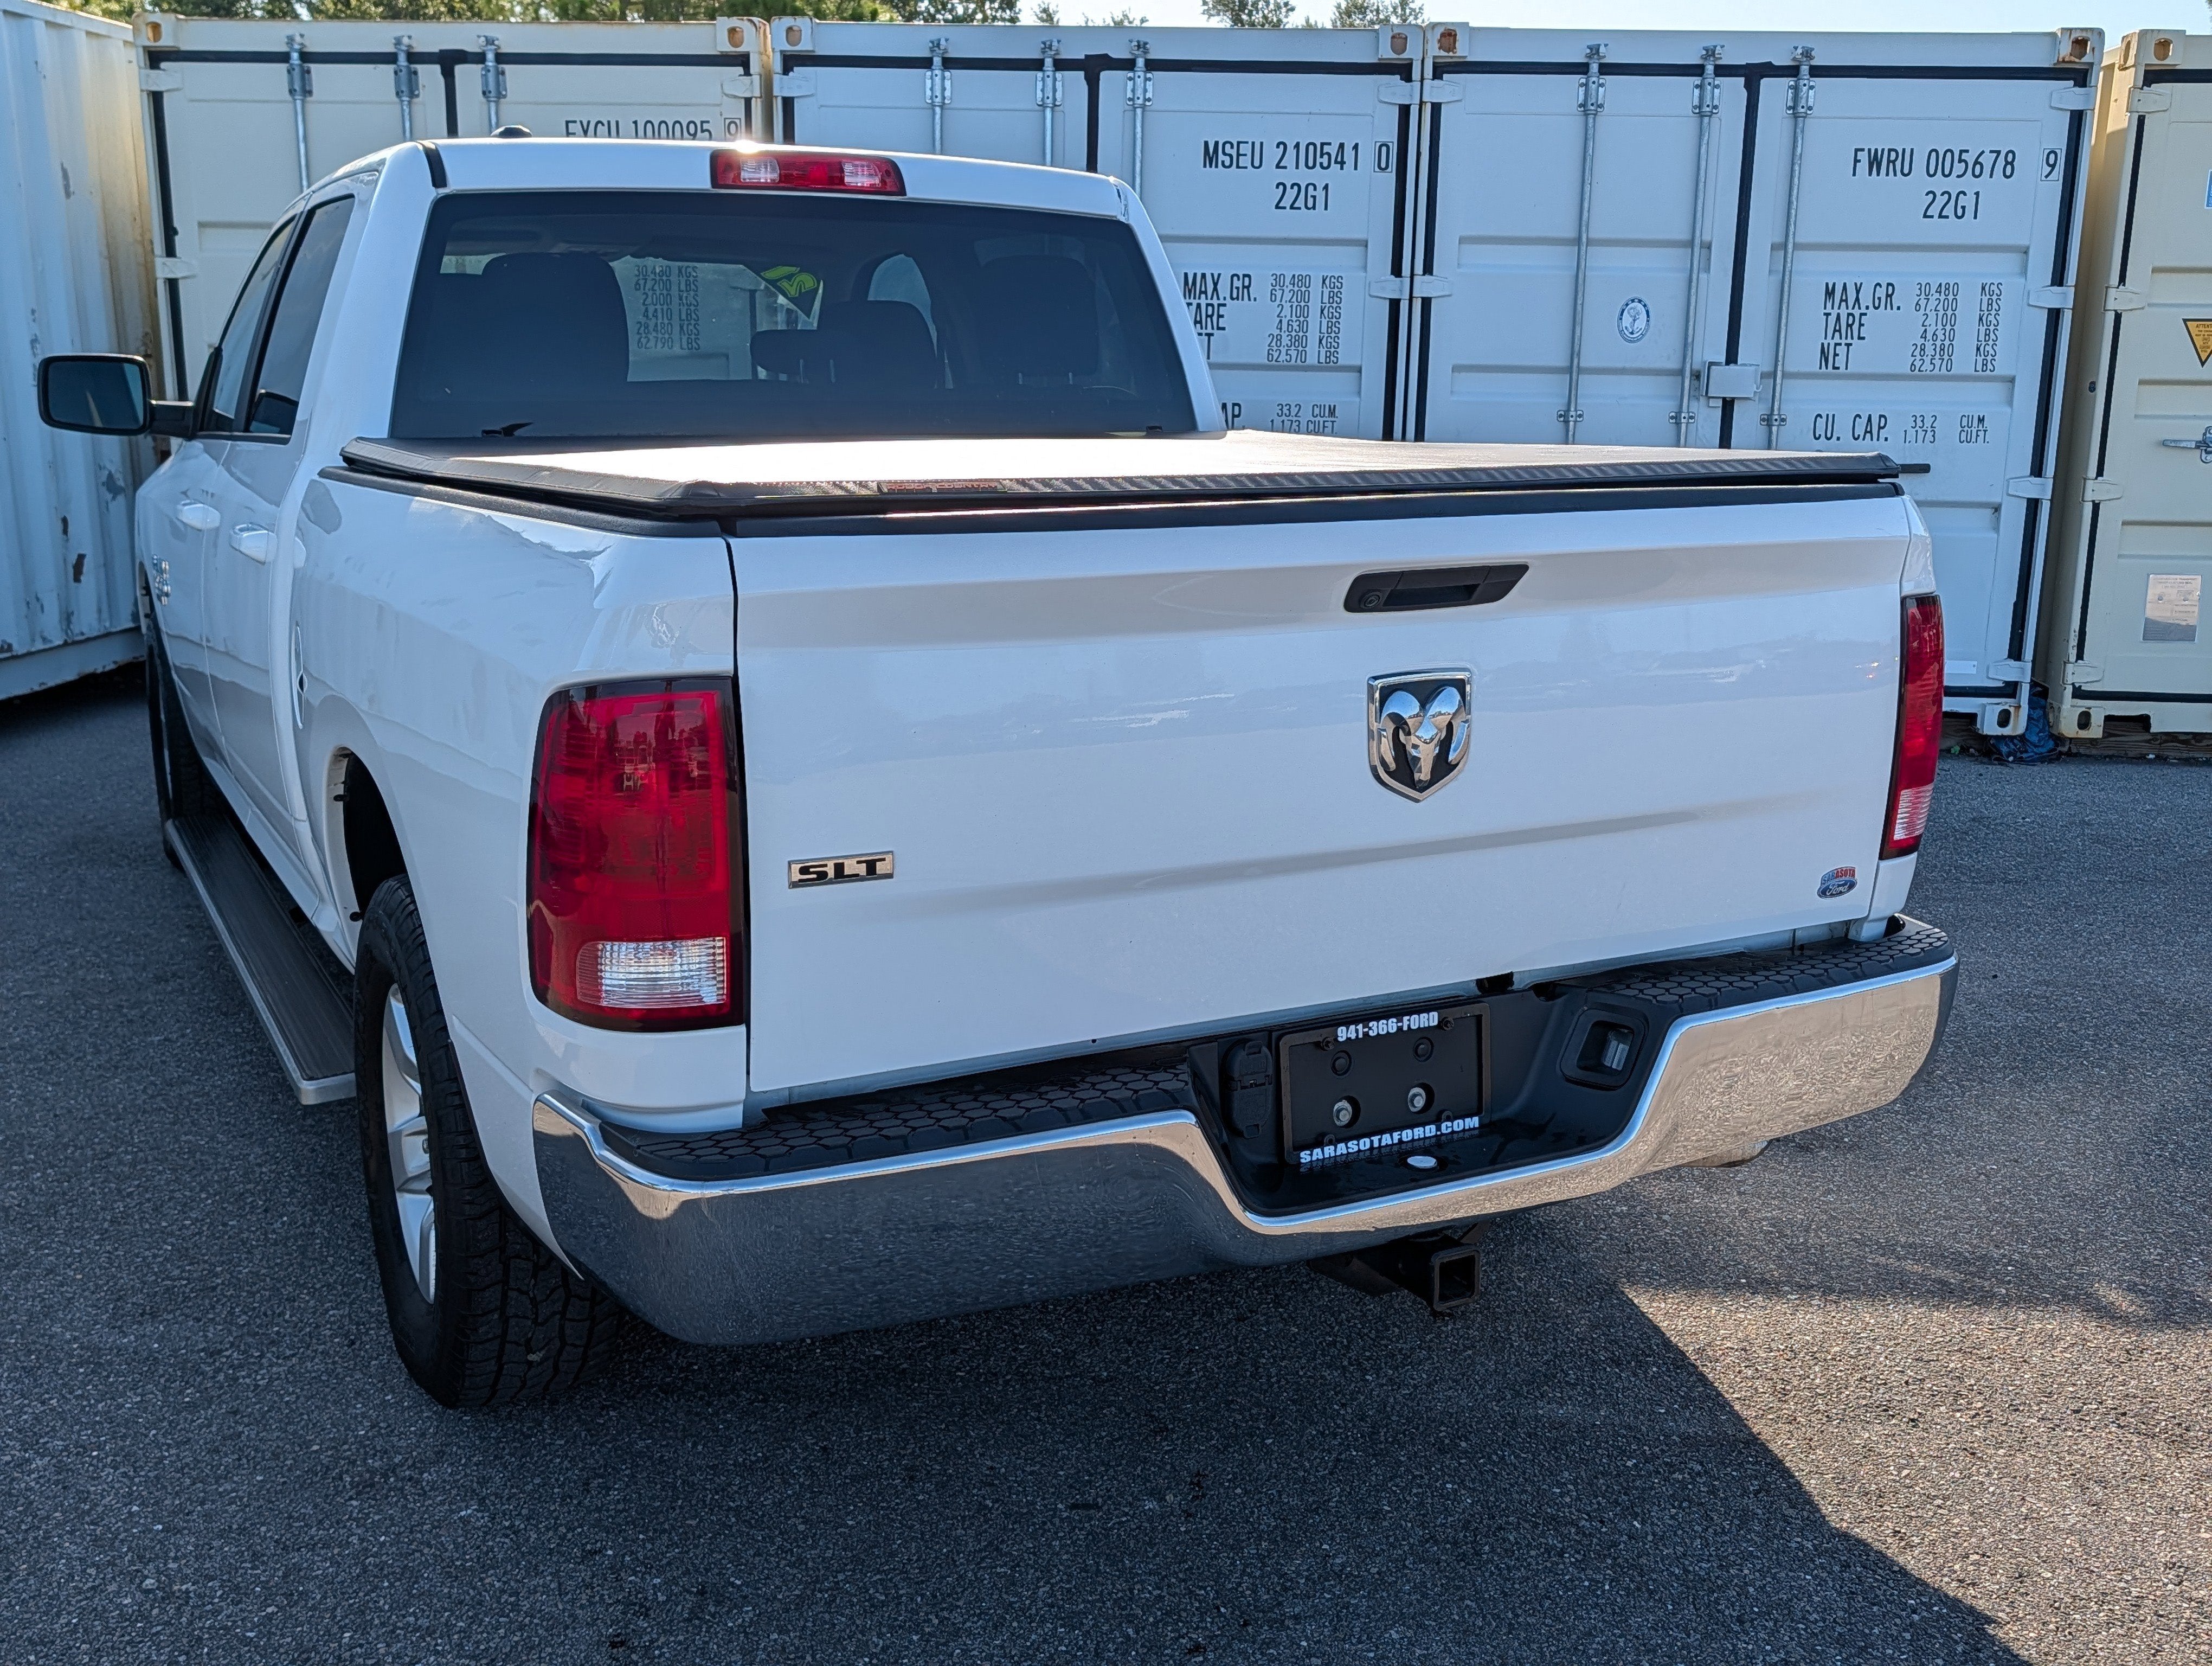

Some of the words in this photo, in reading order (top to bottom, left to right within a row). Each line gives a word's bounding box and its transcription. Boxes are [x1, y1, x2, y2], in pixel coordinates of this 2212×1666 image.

[632, 119, 712, 140] 100095
[1203, 140, 1263, 169] MSEU
[1275, 141, 1359, 171] 210541
[1377, 143, 1390, 171] 0
[1852, 148, 1914, 177] FWRU
[1926, 148, 2016, 179] 005678
[2043, 150, 2058, 180] 9
[1274, 182, 1329, 211] 22G1
[1922, 190, 1980, 220] 22G1
[678, 265, 698, 279] KGS
[678, 279, 698, 292] LBS
[1183, 272, 1257, 302] MAX.GR.
[1321, 274, 1343, 290] KGS
[678, 292, 699, 307] KGS
[1321, 290, 1342, 305] LBS
[1823, 282, 1901, 311] MAX.GR.
[1980, 282, 2003, 297] KGS
[1319, 305, 1341, 319] KGS
[1979, 298, 2002, 312] LBS
[679, 307, 699, 322] LBS
[679, 322, 700, 336] KGS
[1319, 319, 1341, 335] LBS
[1823, 312, 1868, 341] TARE
[1978, 312, 2001, 328] KGS
[680, 336, 700, 351] LBS
[1318, 335, 1340, 349] KGS
[1976, 328, 1999, 343] LBS
[1317, 349, 1339, 364] LBS
[1818, 342, 1853, 370] NET
[1975, 343, 1997, 358] KGS
[1973, 357, 1996, 373] LBS
[1276, 403, 1302, 417] 33.2
[1311, 404, 1339, 419] CU.M.
[1812, 413, 1841, 441] CU.
[1851, 413, 1888, 442] CAP.
[1911, 414, 1938, 429] 33.2
[1959, 414, 1988, 429] CU.M.
[1958, 430, 1990, 444] CU.FT.
[798, 857, 886, 883] SLT
[1822, 868, 1855, 885] SARASOTA
[1826, 881, 1850, 895] Ford
[1337, 1011, 1438, 1042] 941-366-FORD
[1300, 1116, 1480, 1163] SARASOTAFORD.COM
